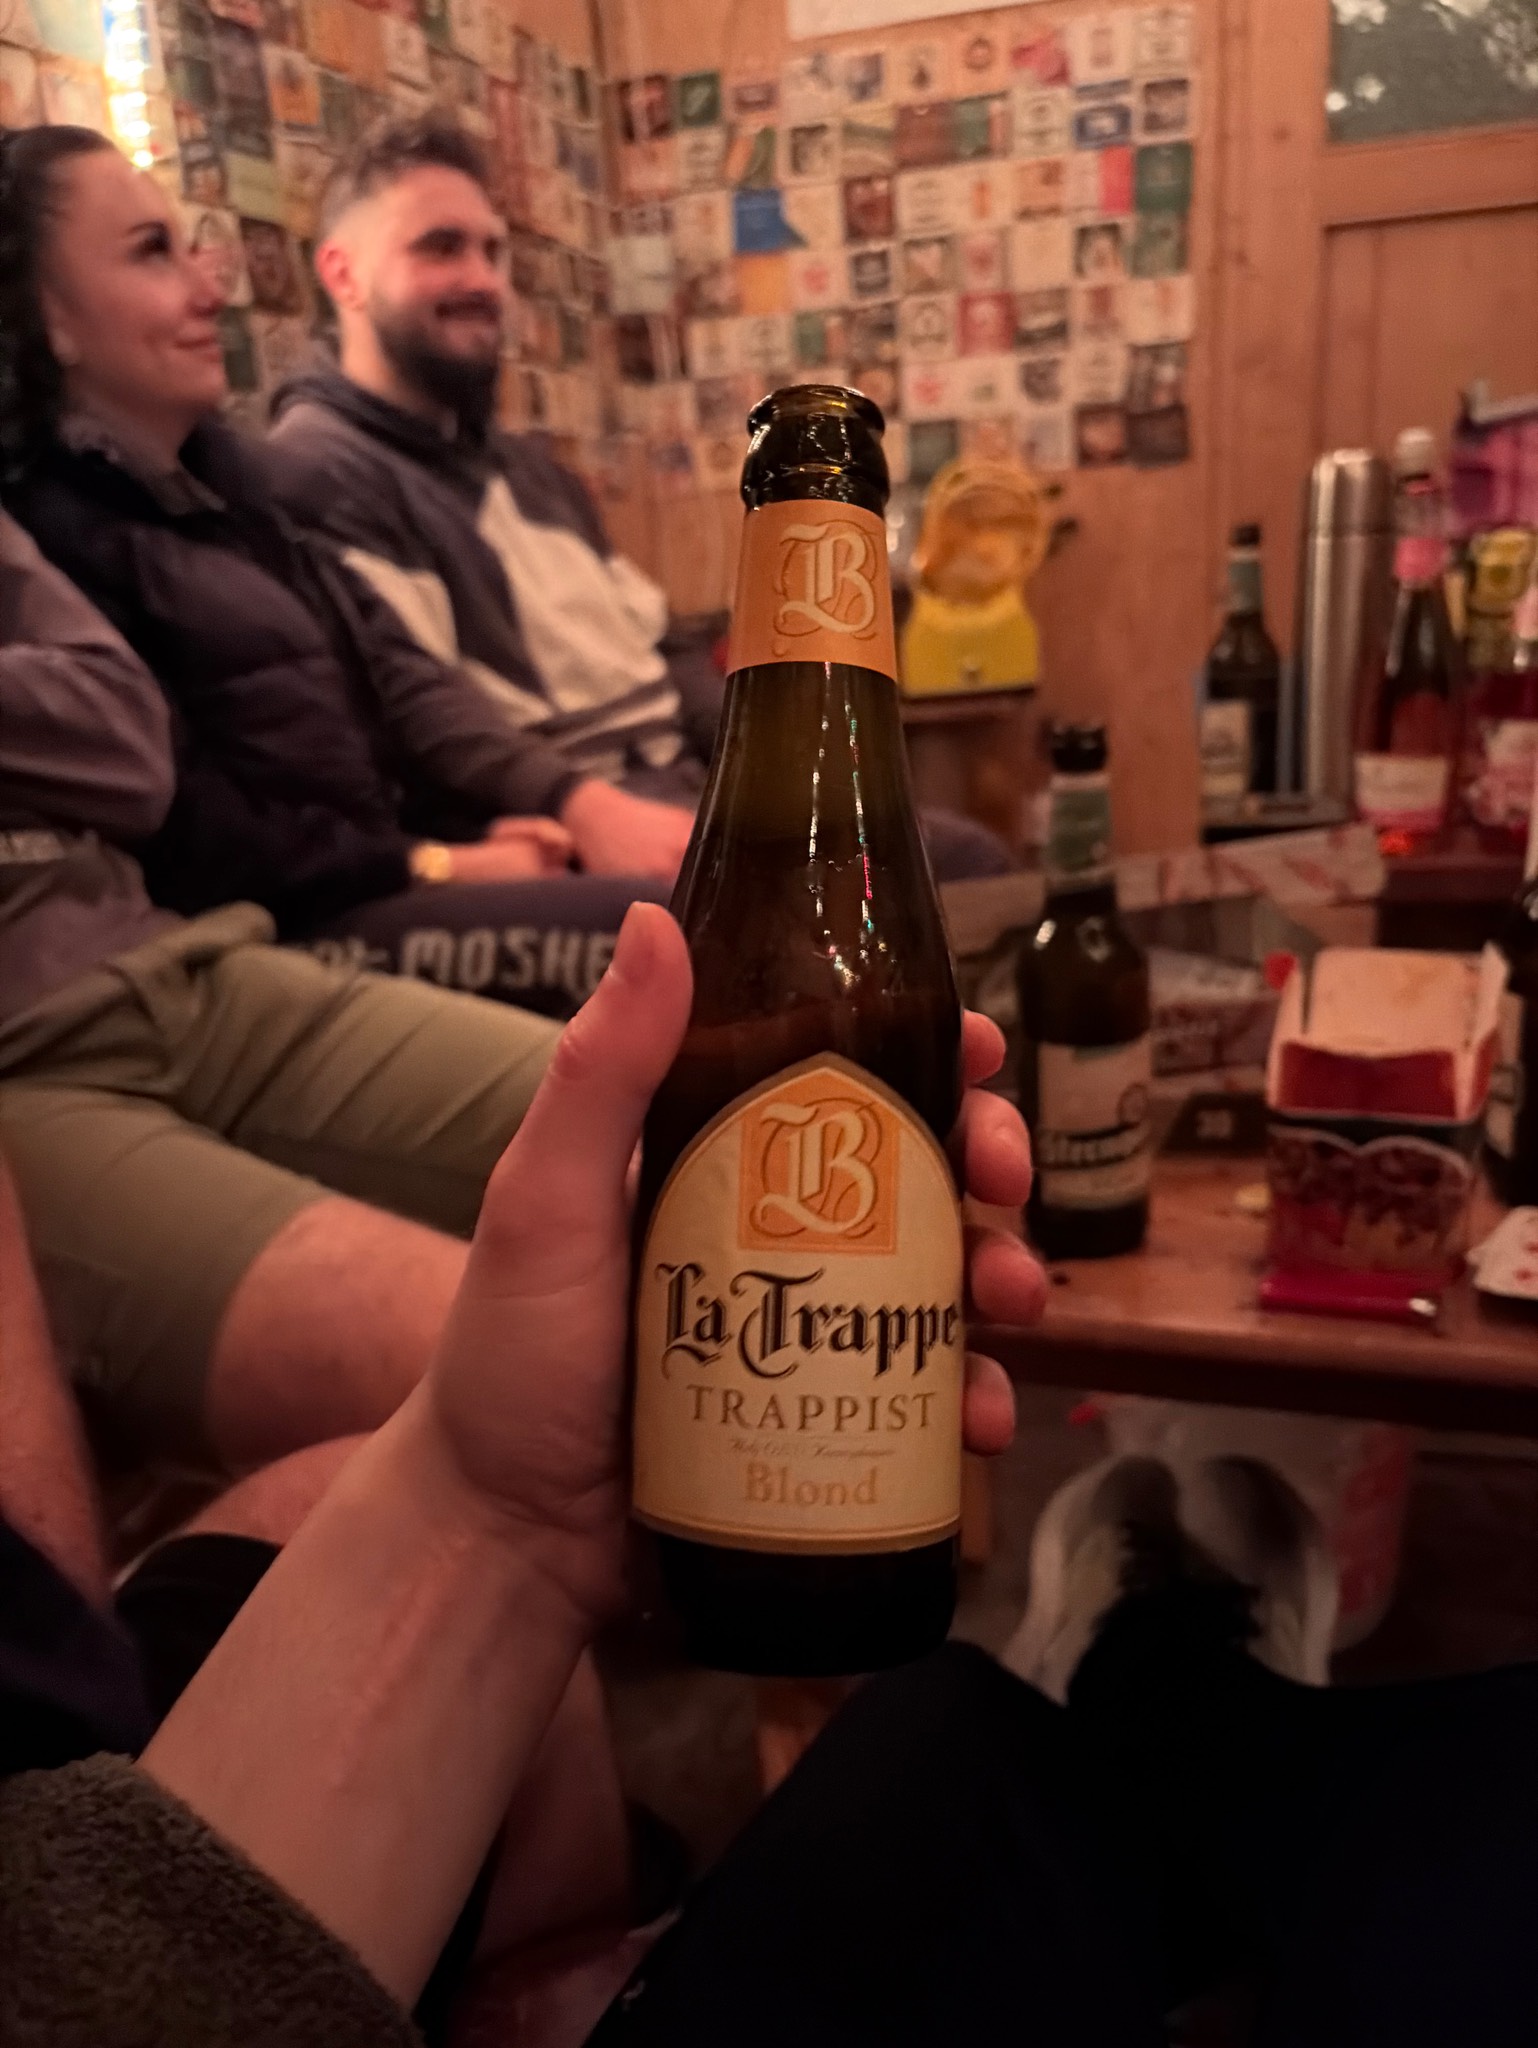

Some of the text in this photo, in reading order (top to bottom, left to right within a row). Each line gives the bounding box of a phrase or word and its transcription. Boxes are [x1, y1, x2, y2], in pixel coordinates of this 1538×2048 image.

[655, 1262, 960, 1380] La Trappe
[687, 1384, 936, 1432] TRAPPIST
[744, 1461, 879, 1507] Blond
